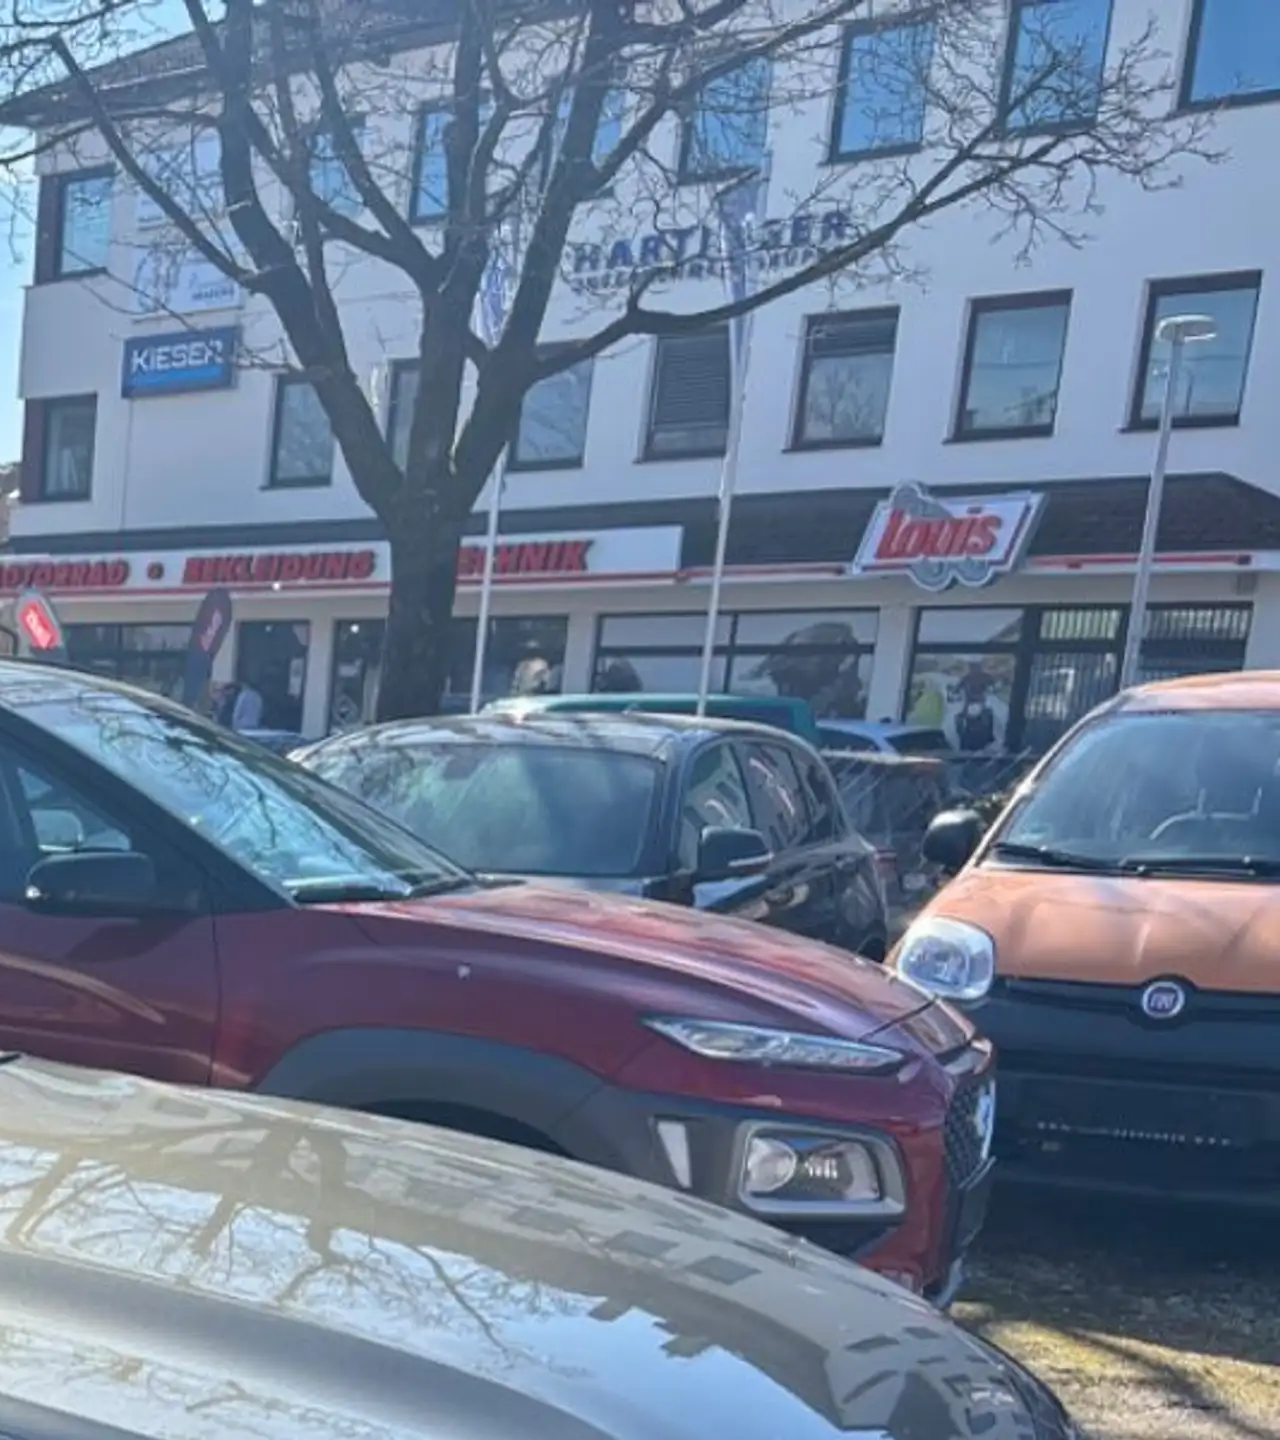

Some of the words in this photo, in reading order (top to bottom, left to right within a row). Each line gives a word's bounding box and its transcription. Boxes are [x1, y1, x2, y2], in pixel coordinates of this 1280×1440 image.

[130, 338, 224, 374] KIESER
[874, 505, 1004, 560] Louis
[182, 550, 378, 585] BEKLEIDUNG
